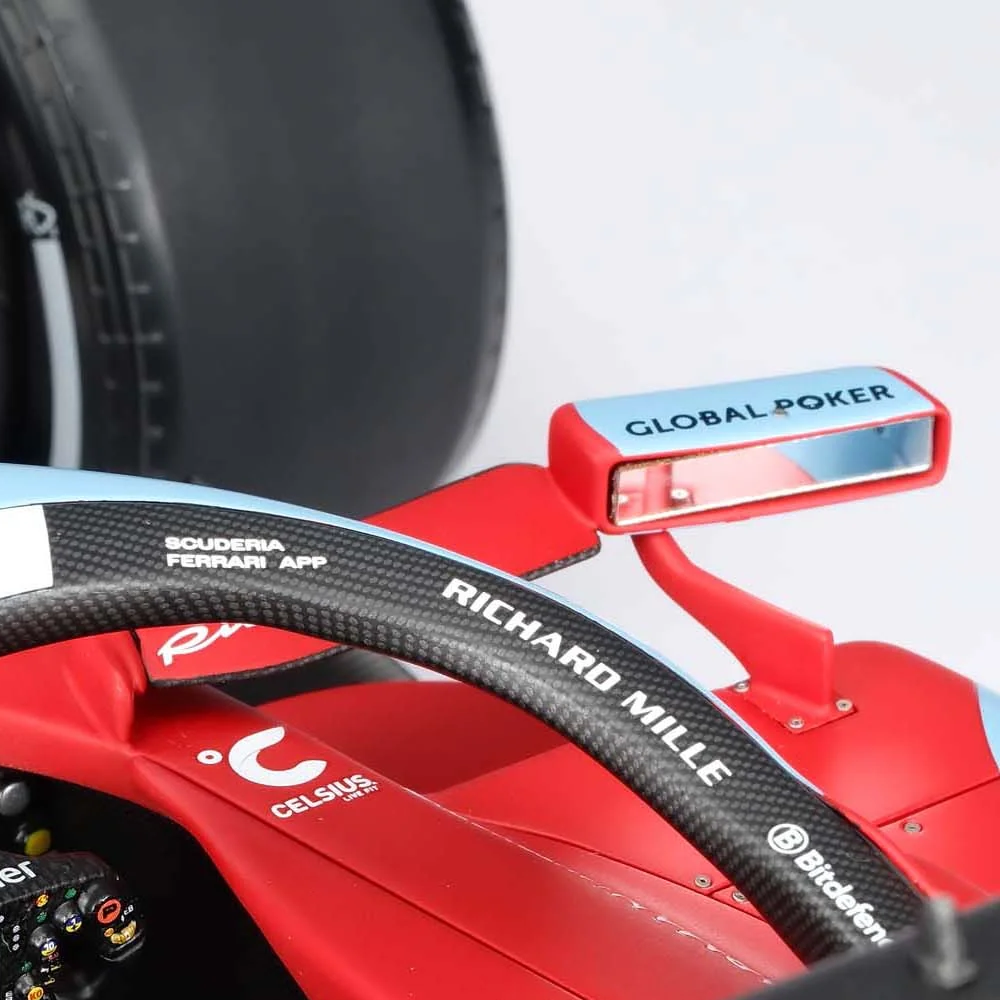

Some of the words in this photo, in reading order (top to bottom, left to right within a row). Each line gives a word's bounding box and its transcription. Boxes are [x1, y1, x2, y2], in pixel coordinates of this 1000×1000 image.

[625, 404, 767, 436] GLOBAL
[770, 384, 895, 417] POKER
[164, 536, 286, 553] SCUDERIA
[165, 553, 268, 570] FERRARI
[278, 555, 328, 570] APP
[441, 577, 622, 693] RICHARD
[619, 689, 733, 787] MILLE
